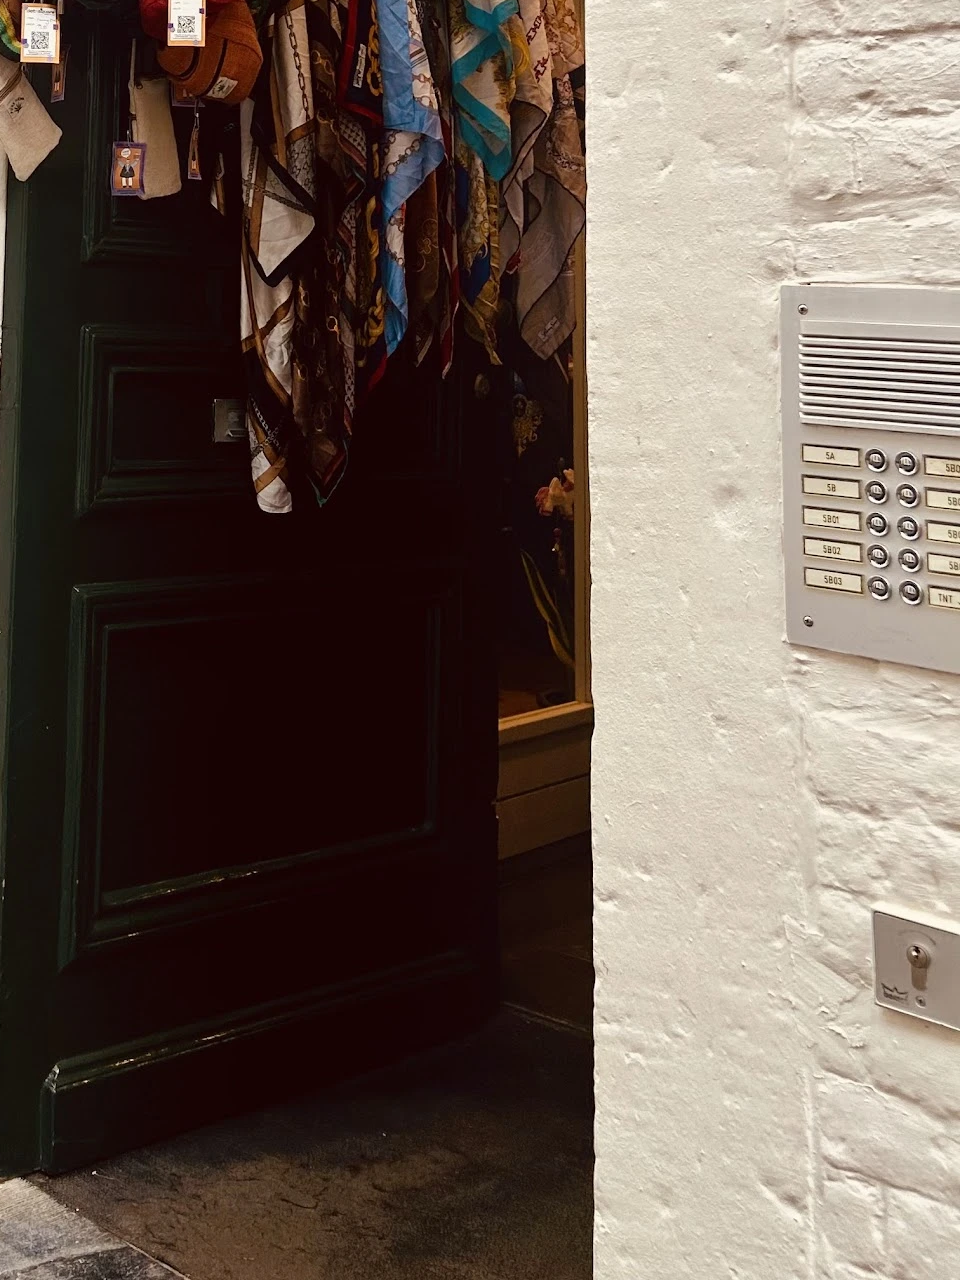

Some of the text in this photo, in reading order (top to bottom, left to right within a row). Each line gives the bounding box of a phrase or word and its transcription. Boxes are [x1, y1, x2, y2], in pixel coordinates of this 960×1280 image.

[825, 452, 835, 460] 5A
[827, 483, 836, 492] 5B
[822, 514, 839, 524] 5B01
[822, 544, 841, 555] 5B02
[824, 575, 842, 585] 5B03
[937, 592, 953, 604] TNT
